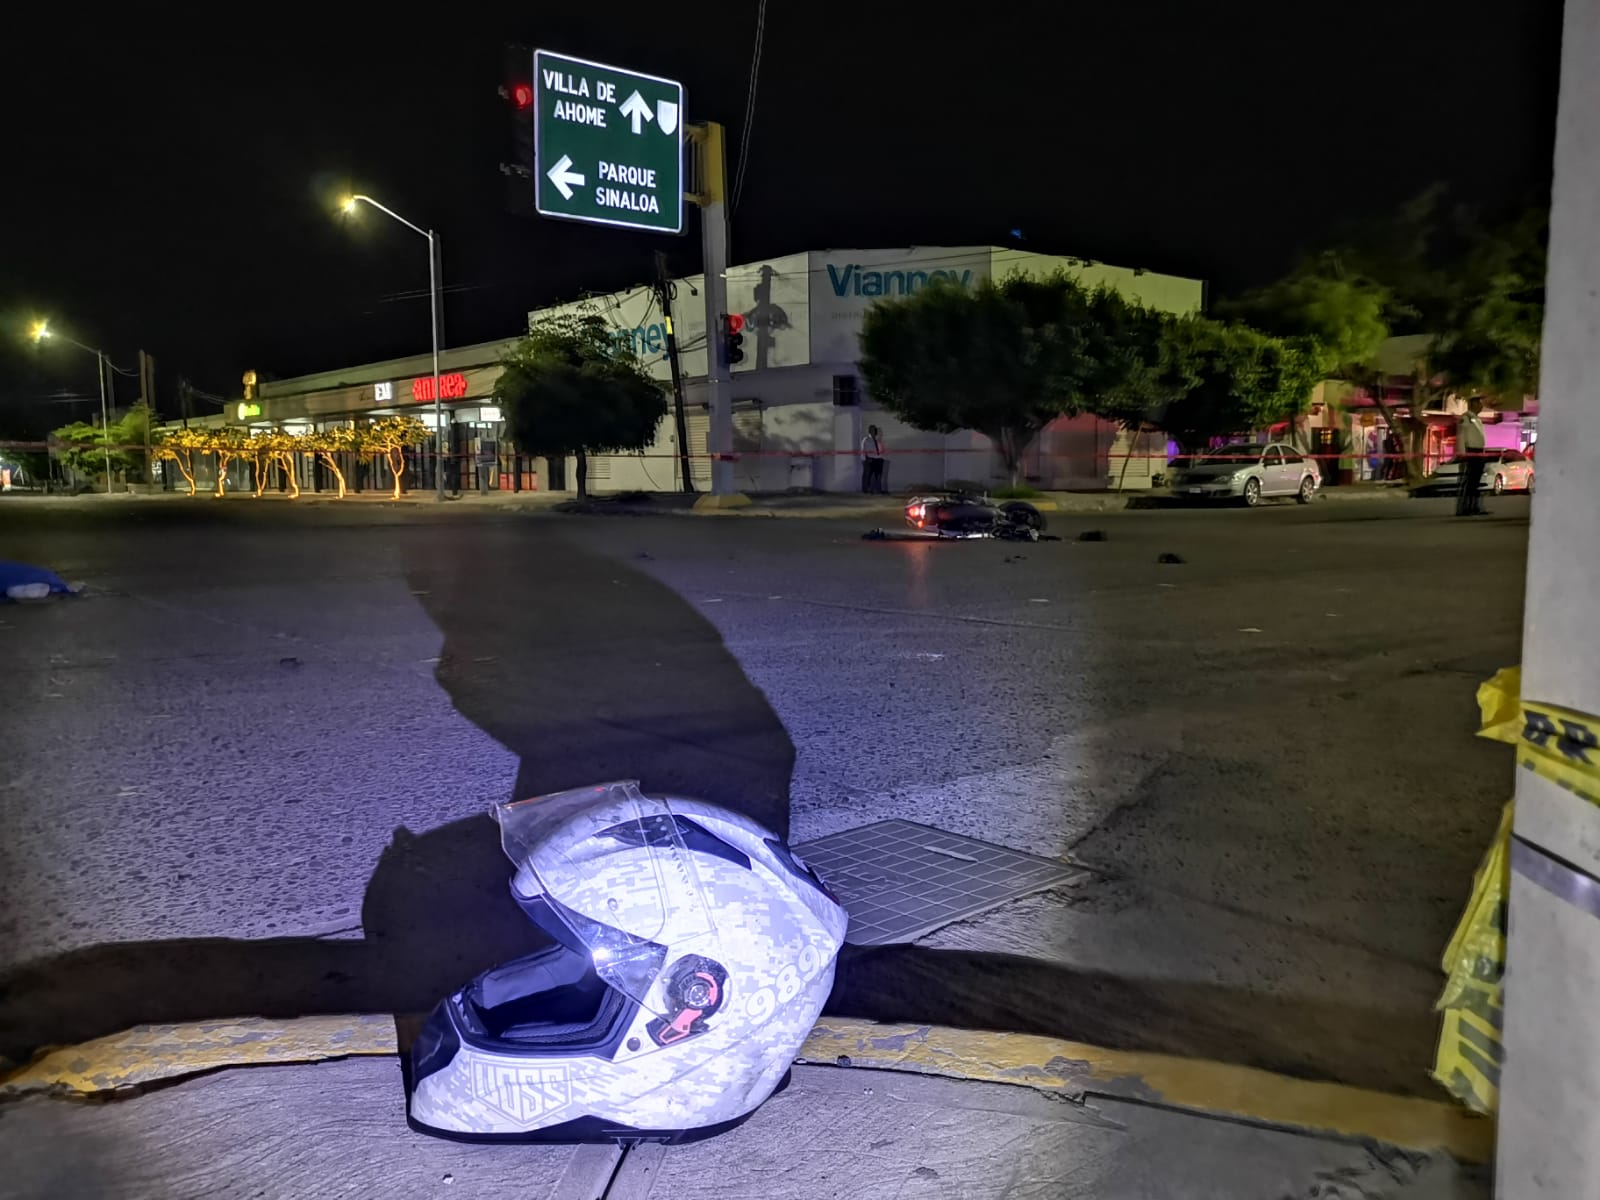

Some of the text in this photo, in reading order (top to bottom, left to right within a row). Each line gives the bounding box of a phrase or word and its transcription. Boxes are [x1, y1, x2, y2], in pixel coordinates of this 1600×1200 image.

[543, 69, 616, 103] VILLA DE
[554, 100, 606, 127] AHOME
[598, 160, 656, 188] PARQUE
[595, 187, 659, 214] SINALOA
[745, 944, 821, 1025] 989
